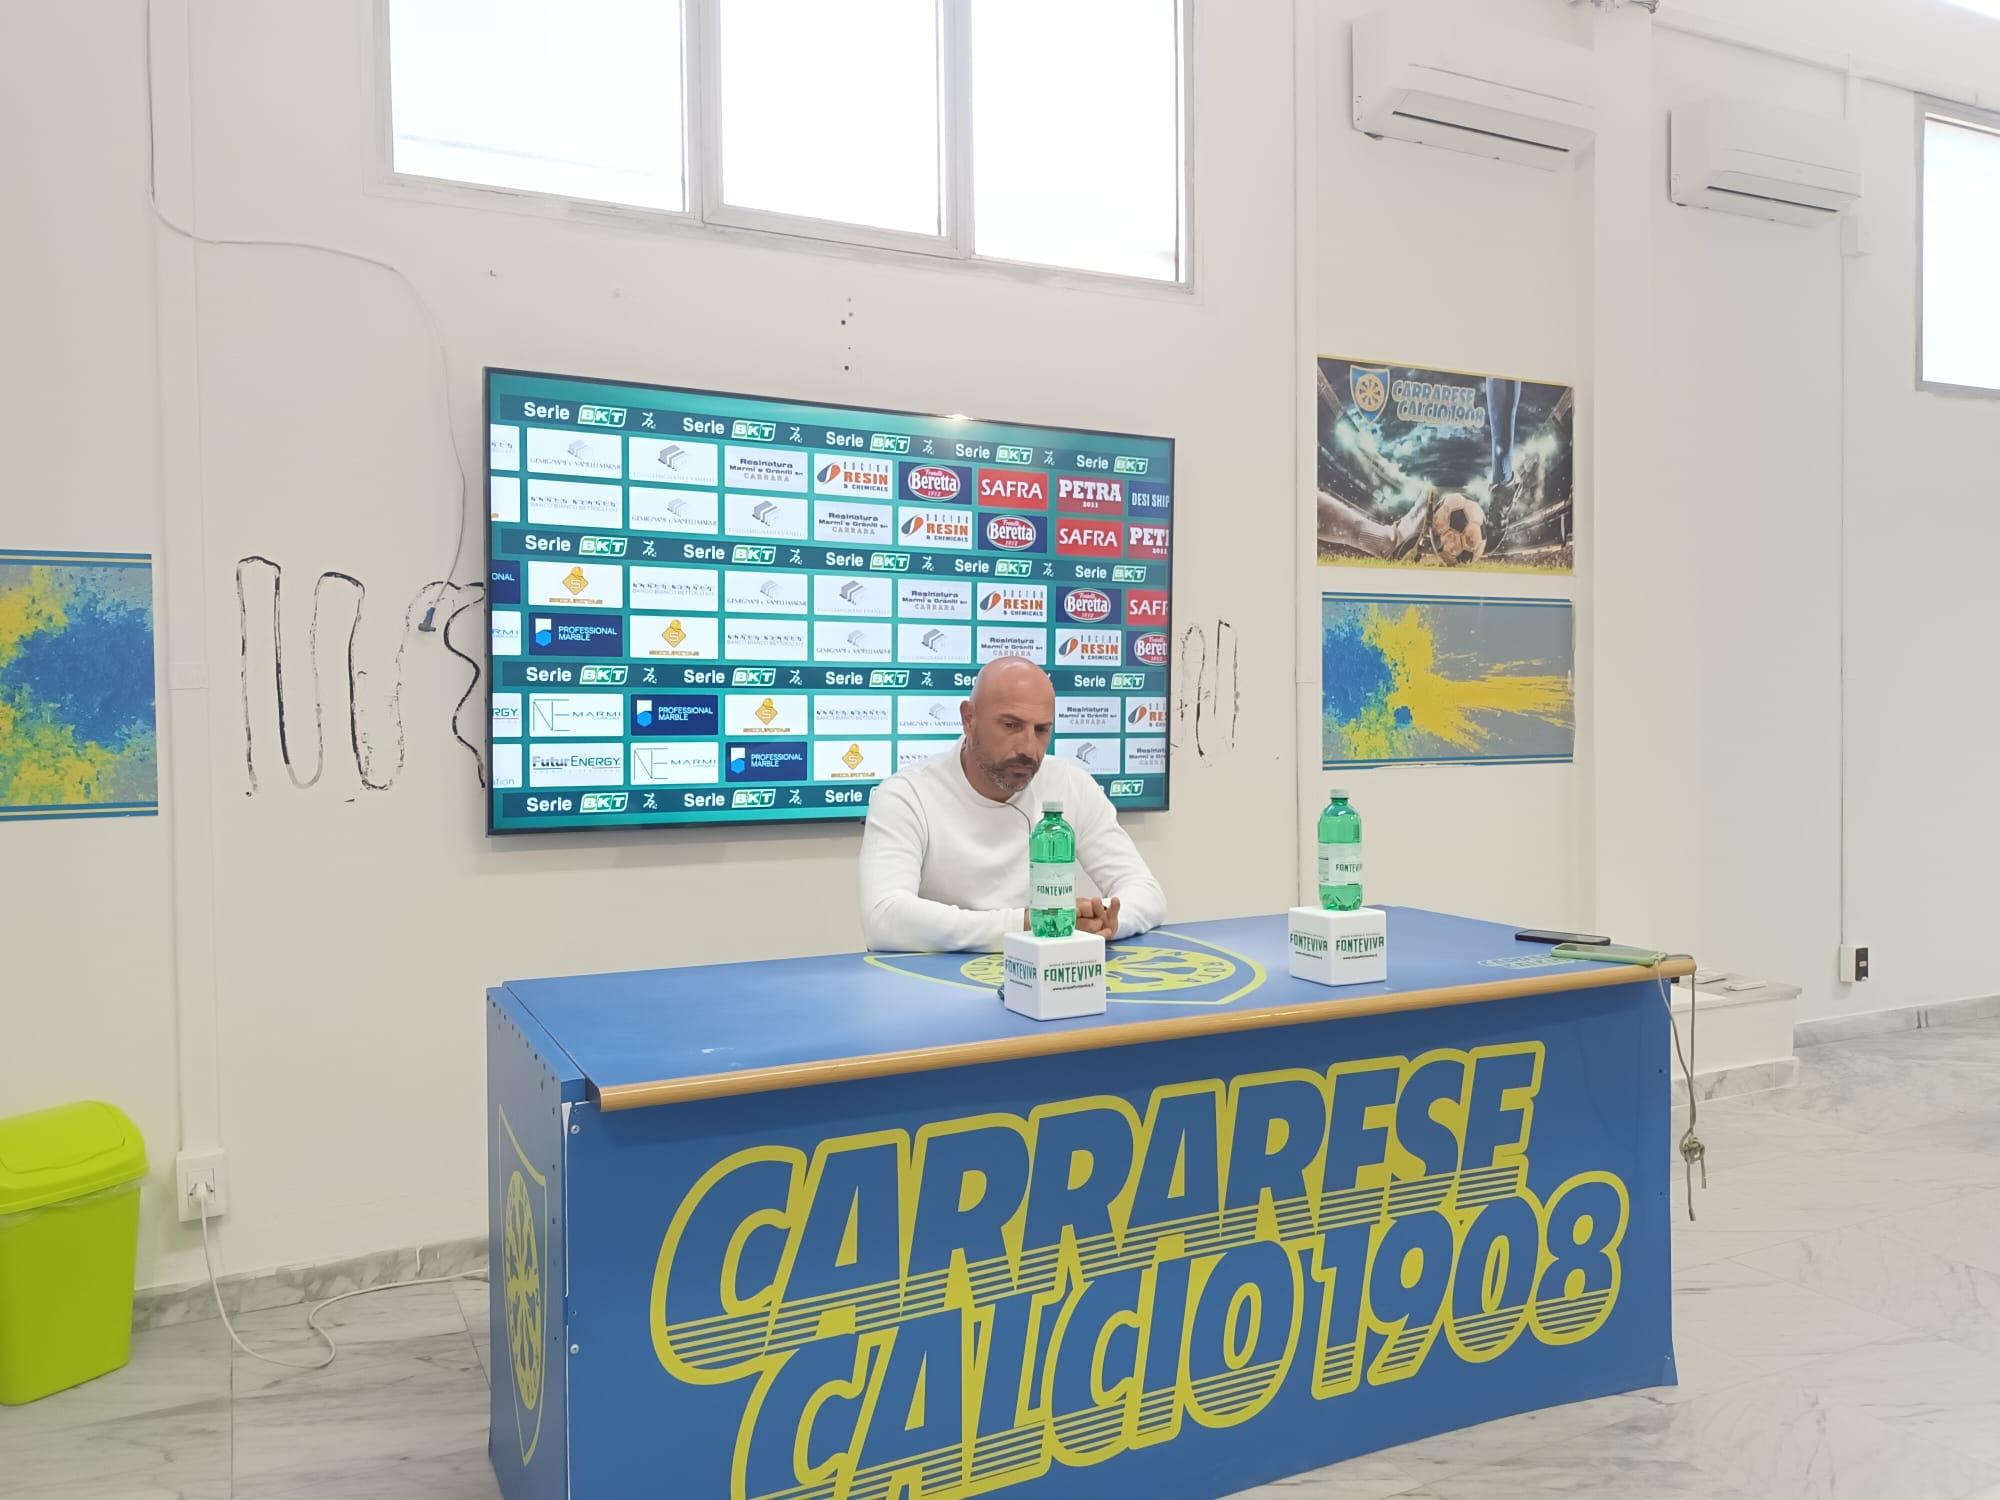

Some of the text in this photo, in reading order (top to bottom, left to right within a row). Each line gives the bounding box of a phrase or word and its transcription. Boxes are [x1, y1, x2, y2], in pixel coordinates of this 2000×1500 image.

[1392, 380, 1476, 402] CARRARESE
[524, 402, 625, 426] Serie BKT
[683, 417, 775, 440] Serie BKT
[826, 431, 909, 452] Serie BKT
[955, 444, 1032, 464] Serie BKT
[740, 458, 793, 469] Resinatura
[1076, 455, 1147, 473] Serie BKT
[843, 471, 888, 485] RESIN
[911, 472, 957, 491] Beretta
[981, 479, 1043, 500] SAFRA
[1059, 479, 1122, 502] PETRA
[1132, 493, 1150, 507] DESI
[828, 512, 878, 522] Resinatura
[926, 524, 968, 536] RESIN
[989, 523, 1033, 541] Beretta
[1059, 528, 1118, 547] SAFRA
[525, 535, 627, 556] Serie BKT
[683, 544, 775, 563] Serie BKT
[826, 552, 909, 570] Serie BKT
[955, 559, 1031, 576] Serie BKT
[1075, 565, 1146, 582] Serie BKT
[911, 590, 959, 598] Resinatura
[1004, 599, 1043, 610] RESIN
[1067, 596, 1108, 613] Beretta
[558, 626, 617, 636] PROFESSIONAL
[558, 633, 591, 641] MARBLE
[1081, 644, 1118, 654] RESIN
[526, 666, 627, 684] Serie BKT
[684, 668, 775, 685] Serie BKT
[825, 670, 909, 686] Serie BKT
[954, 673, 976, 687] Ser
[1074, 674, 1144, 689] Serie BKT
[572, 710, 621, 718] MARMI
[658, 706, 713, 714] PROFESSIONAL
[658, 713, 689, 721] MARBLE
[532, 755, 621, 768] FuturENERGY
[671, 759, 717, 767] MARMI
[751, 753, 803, 761] PROFESSIONAL
[825, 789, 863, 804] Serie
[1111, 781, 1143, 795] BKT
[527, 793, 627, 812] Serie BKT
[684, 789, 775, 807] Serie BKT
[1037, 885, 1073, 897] FONTEVIVA
[1290, 933, 1328, 952] FONTEVIVA
[1336, 936, 1384, 953] FONTEVIVA
[1005, 959, 1037, 981] FONTEVIVA
[1044, 964, 1102, 983] FONTEVIVA
[651, 1043, 1546, 1384] CARRARESE
[732, 1239, 1304, 1500] CALCIO
[1300, 1171, 1630, 1400] 1908
